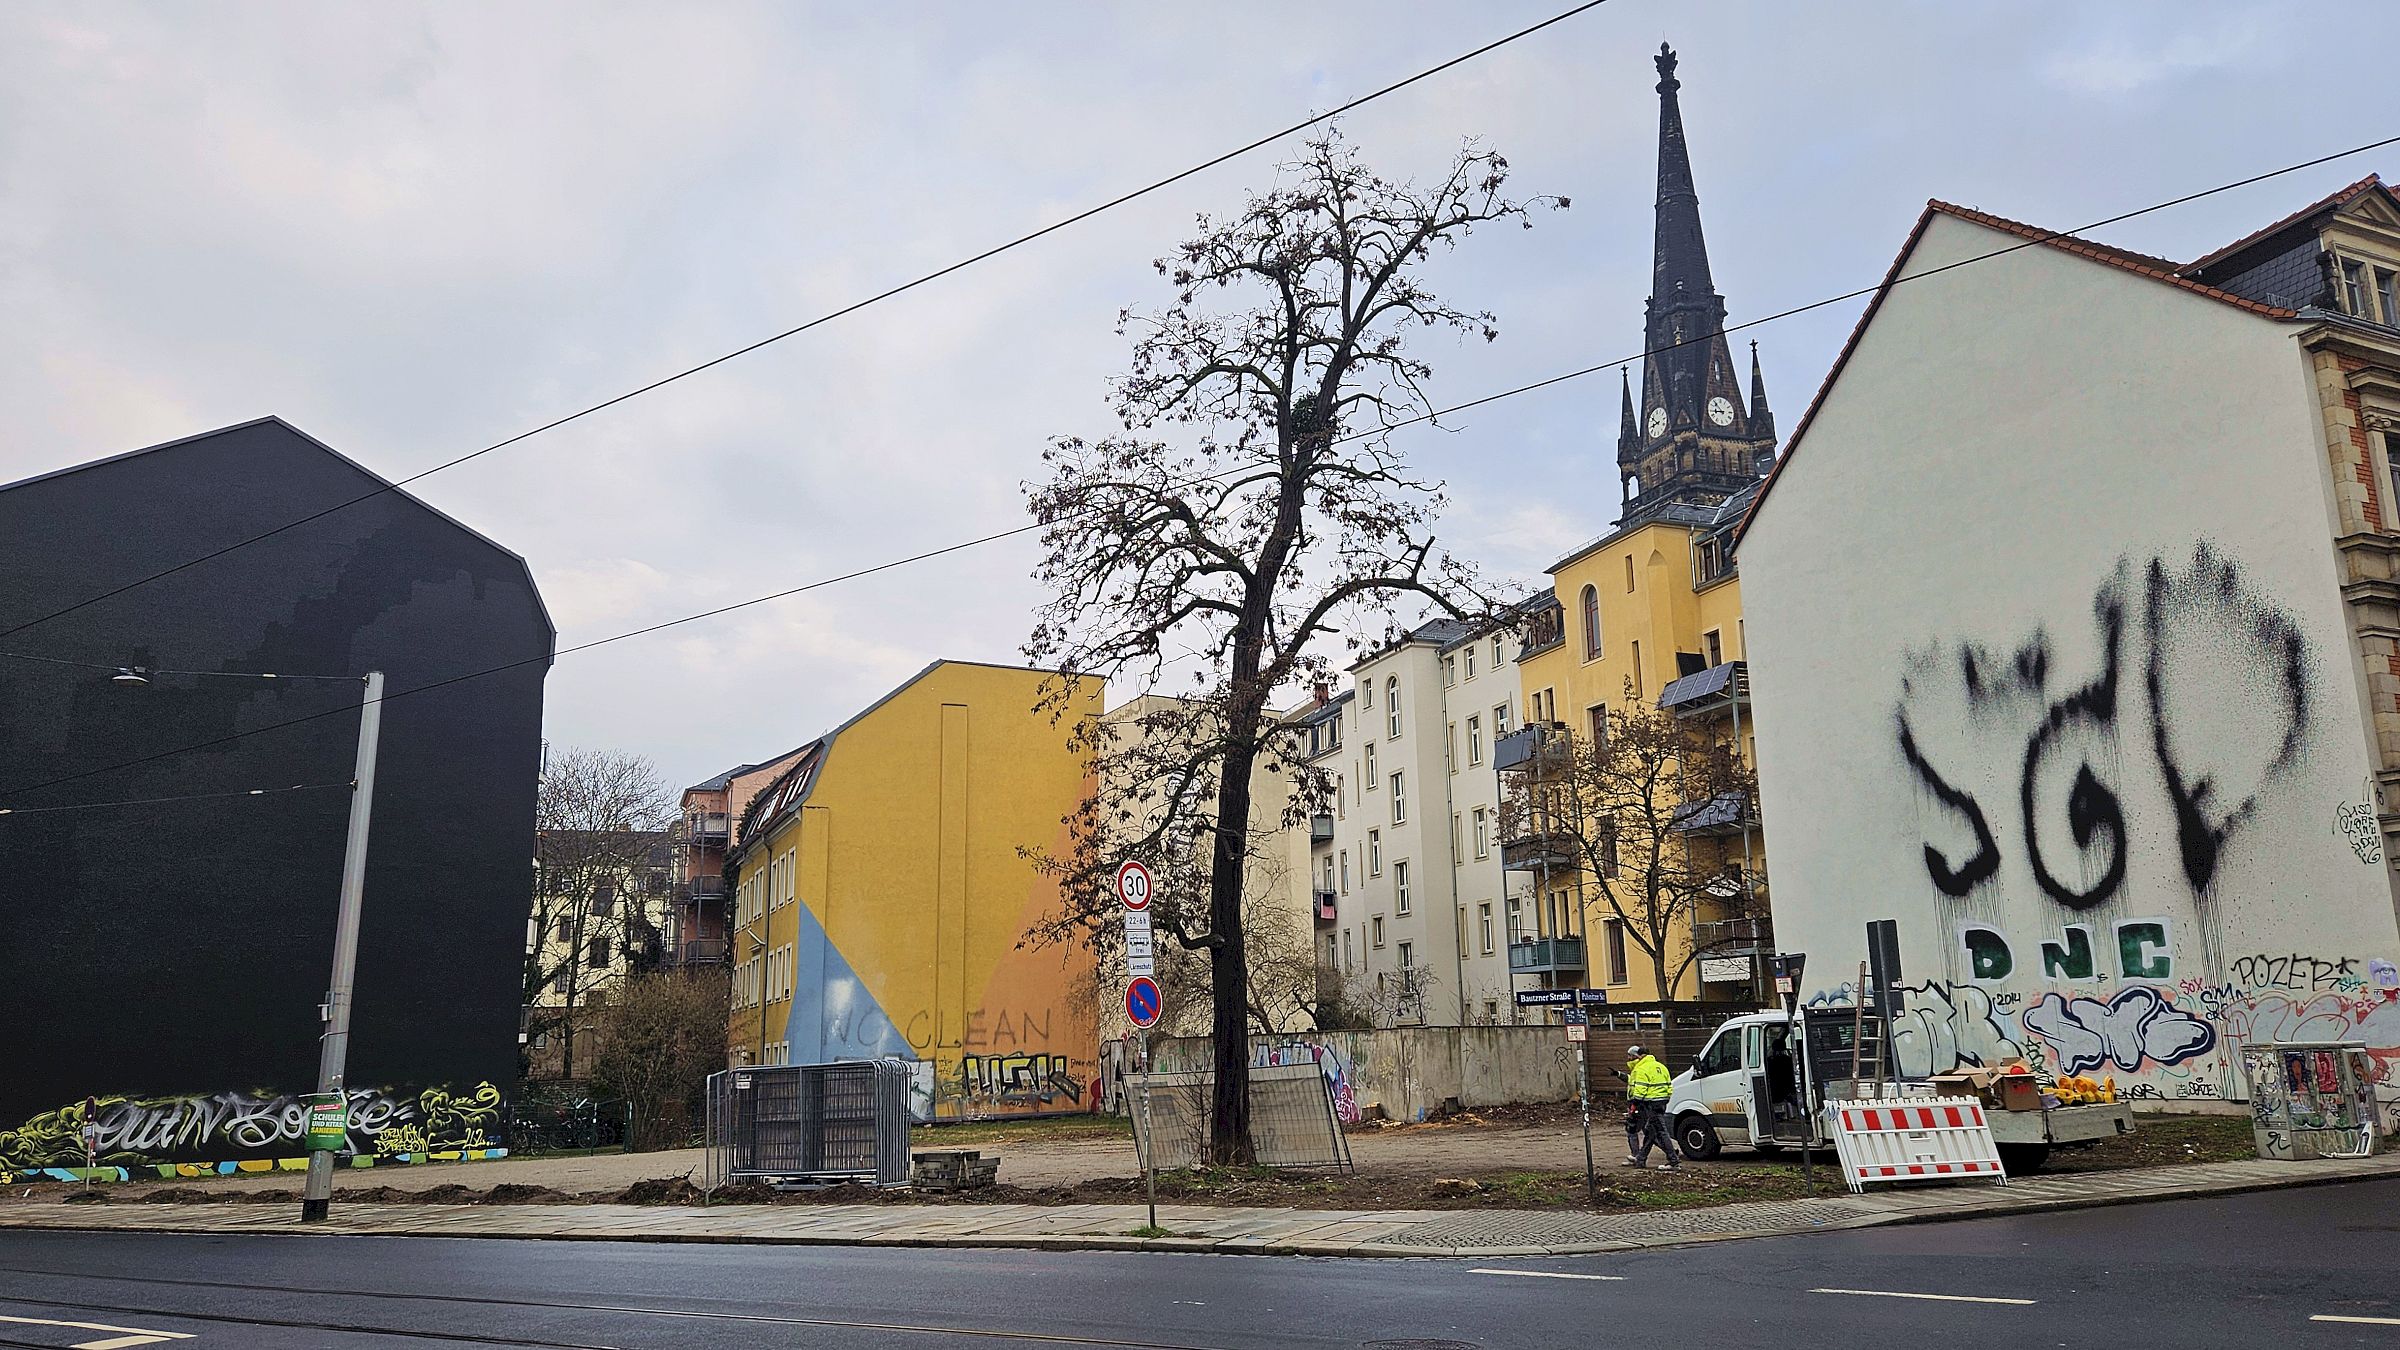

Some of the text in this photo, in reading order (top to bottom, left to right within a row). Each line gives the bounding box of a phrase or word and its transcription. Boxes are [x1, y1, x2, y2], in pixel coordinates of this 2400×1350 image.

[1125, 876, 1145, 897] 30
[1520, 992, 1572, 1003] Bautzner Straße
[906, 1008, 1051, 1049] CLEAN
